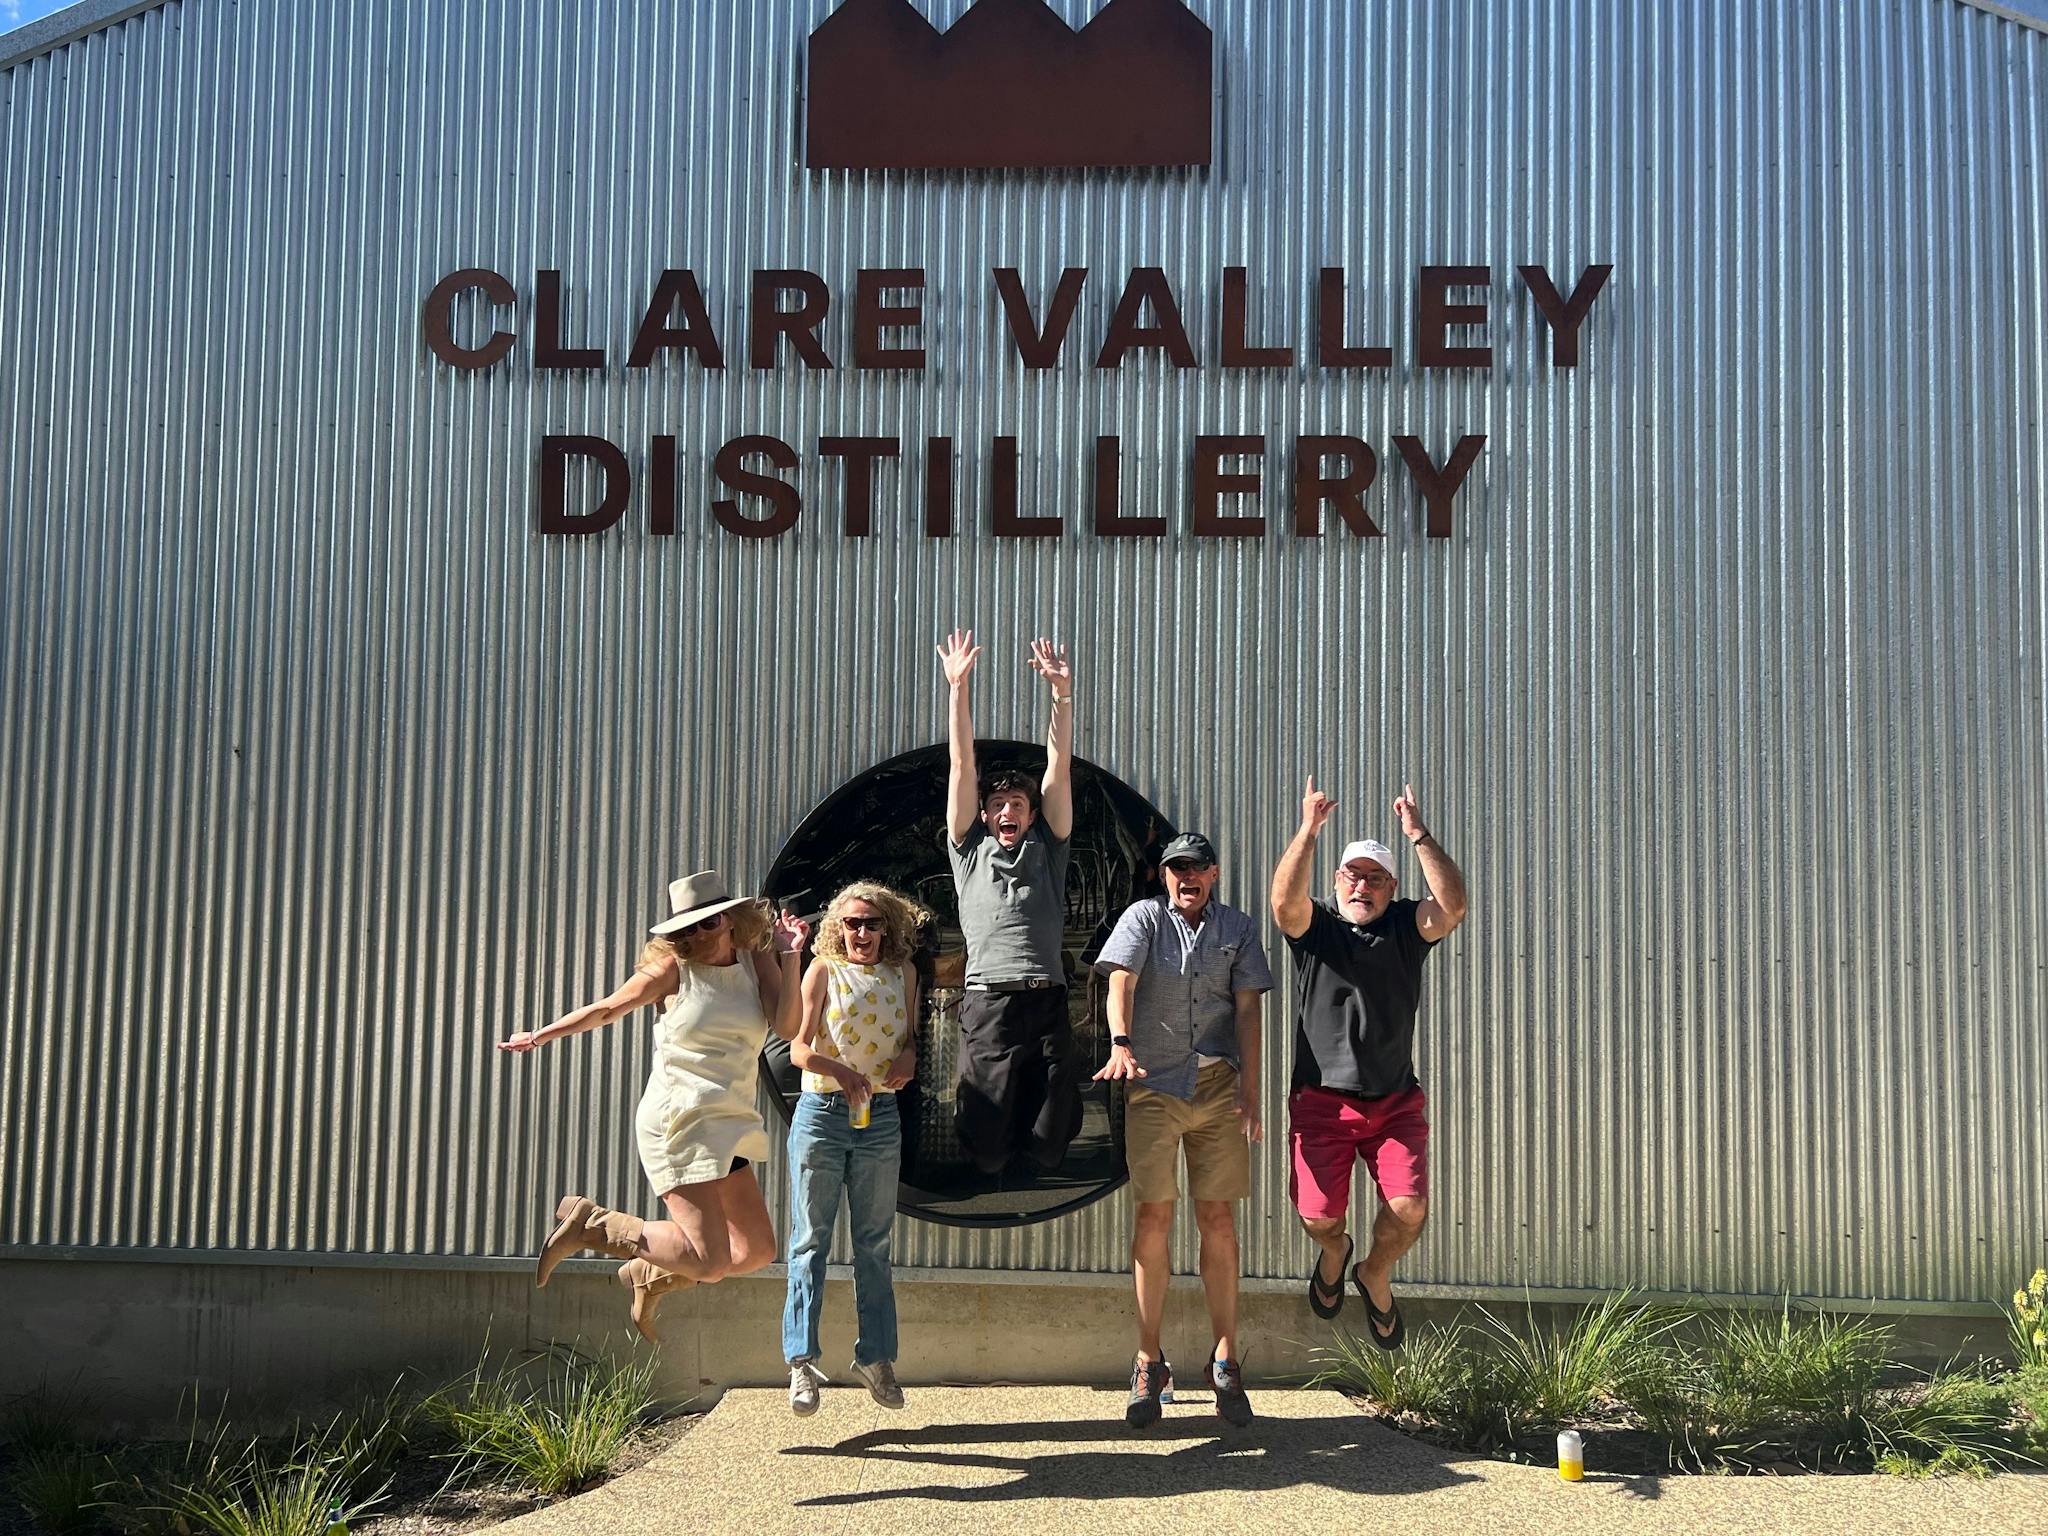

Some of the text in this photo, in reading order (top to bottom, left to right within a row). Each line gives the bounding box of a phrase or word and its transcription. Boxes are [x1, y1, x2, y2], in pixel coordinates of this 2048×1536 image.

[423, 265, 1613, 369] CLARE VALLEY
[541, 434, 1487, 537] DISTILLERY
